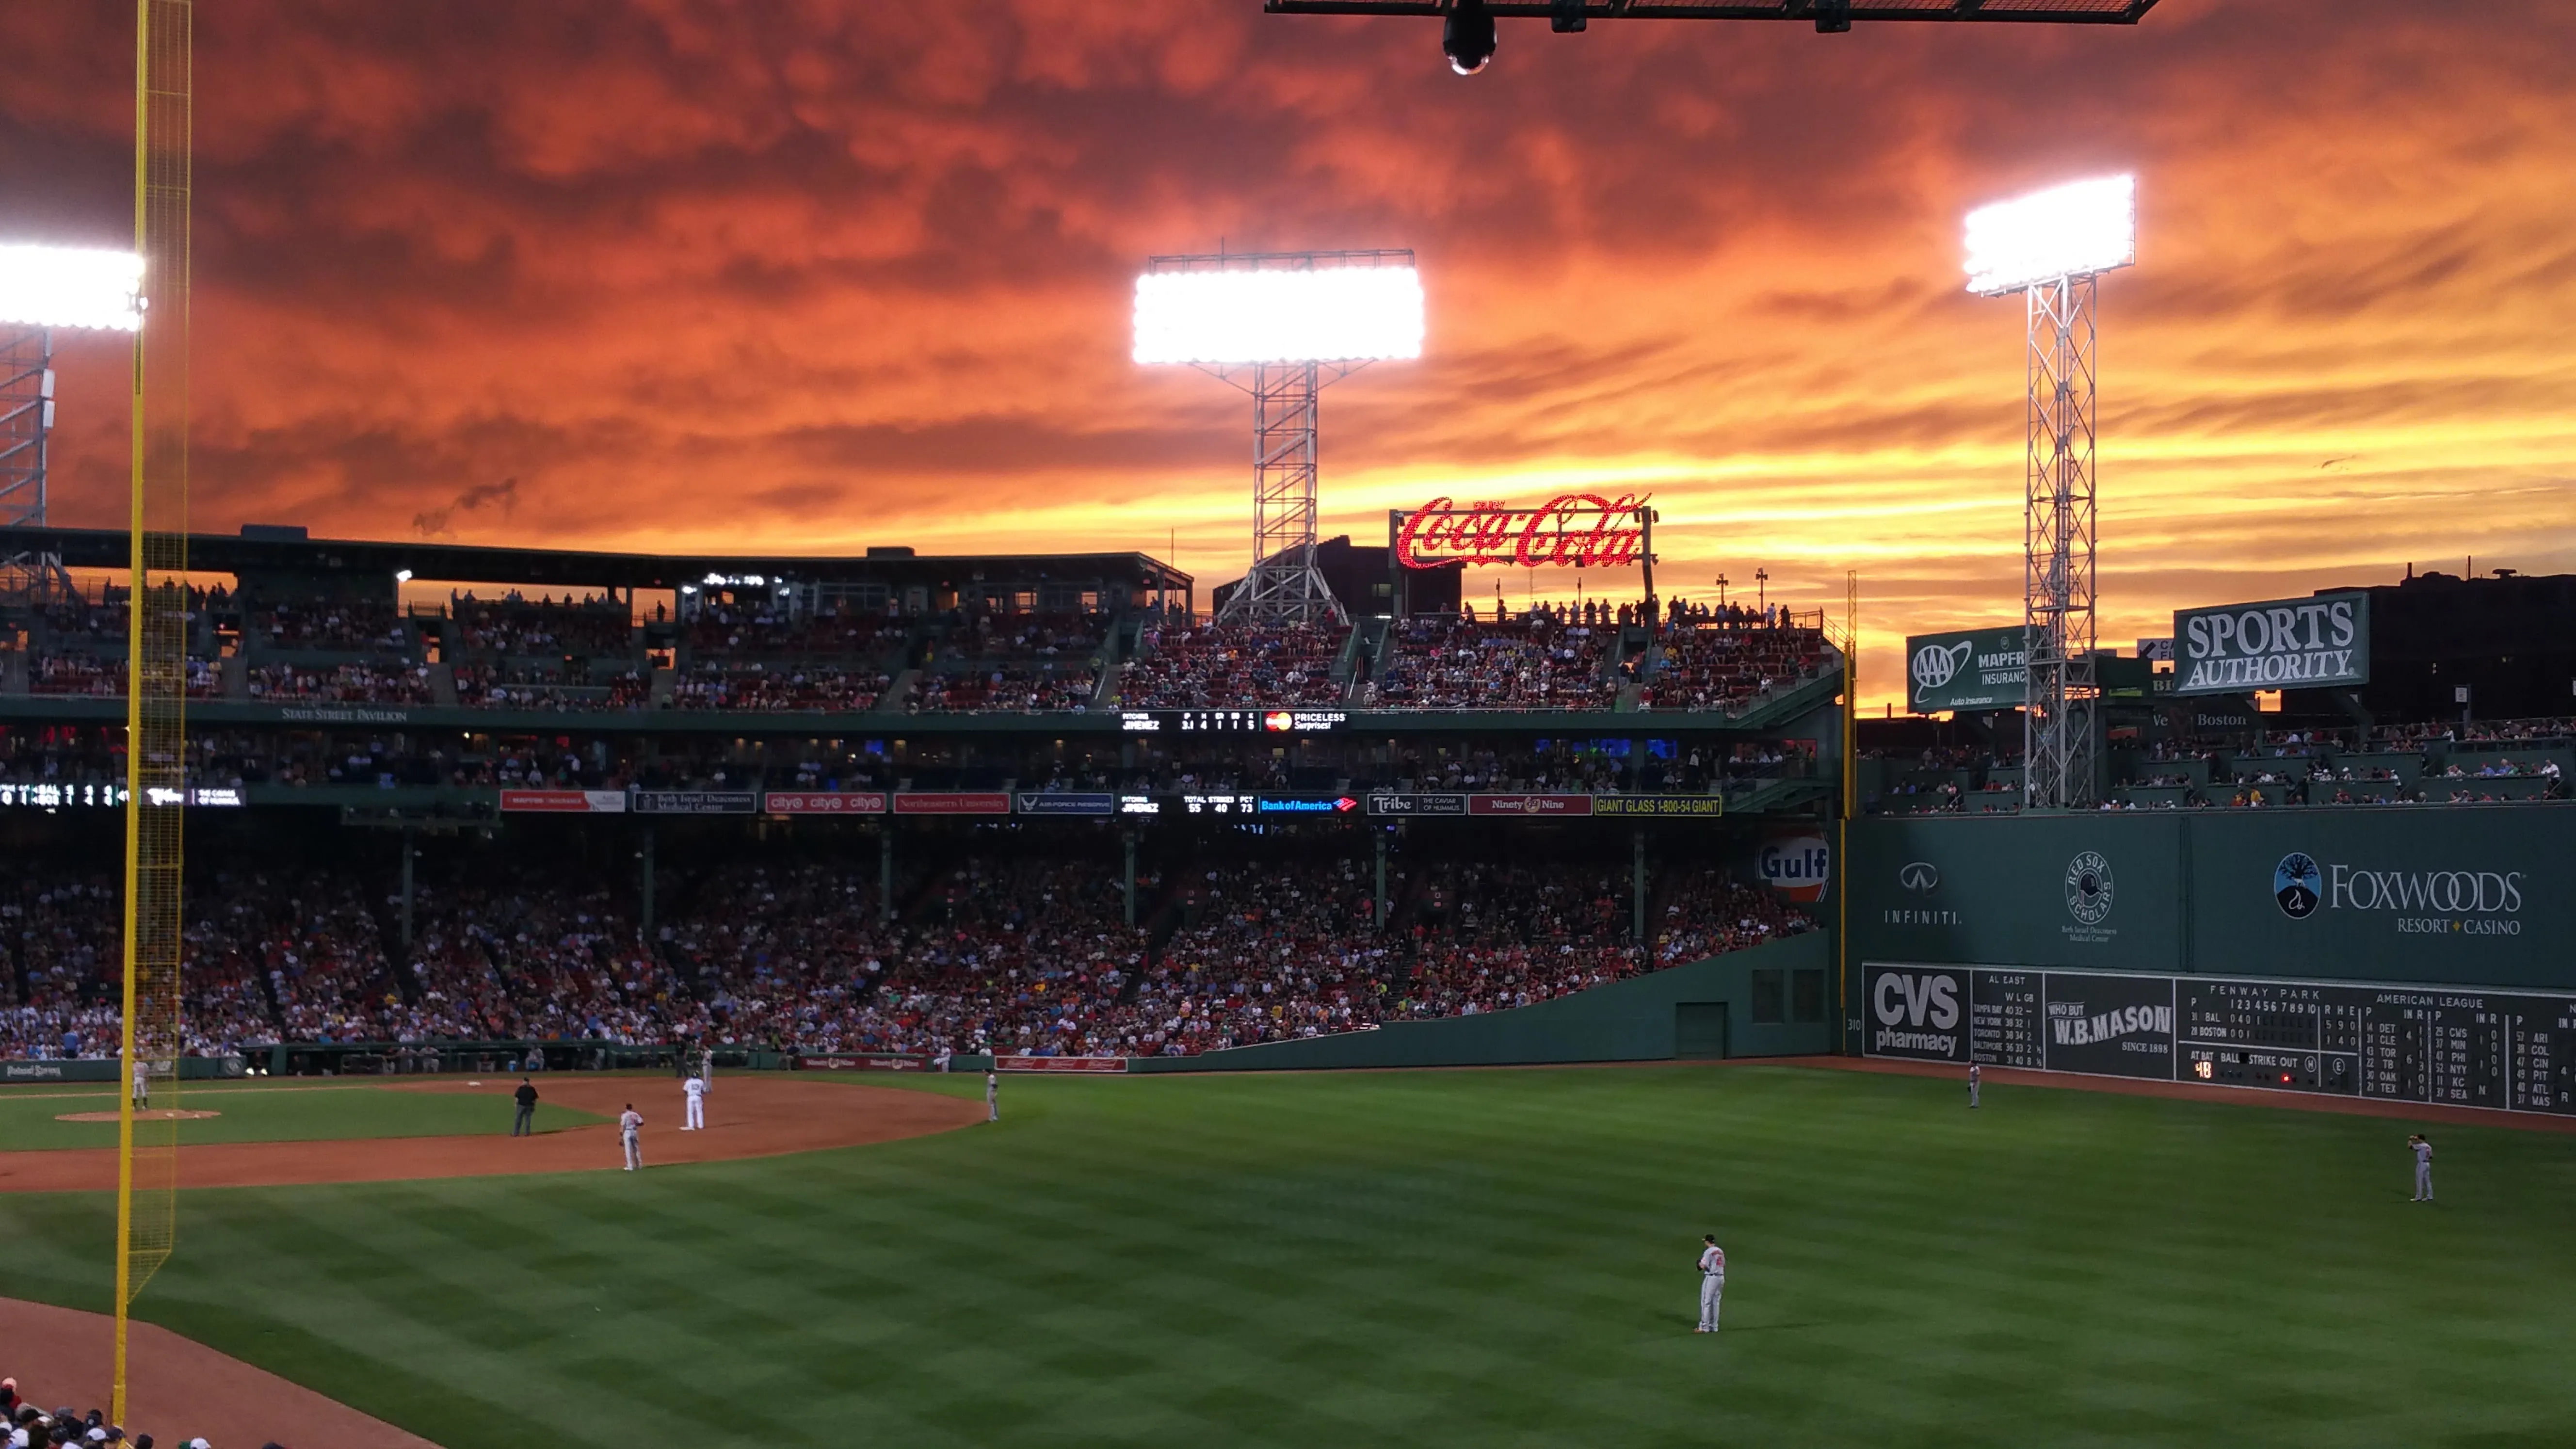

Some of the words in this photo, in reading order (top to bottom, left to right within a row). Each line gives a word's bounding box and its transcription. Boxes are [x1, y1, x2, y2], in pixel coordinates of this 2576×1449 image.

[1396, 492, 1651, 569] Coca-Cola
[2187, 601, 2354, 659] SPORTS
[1978, 651, 2025, 668] MAPFR
[1918, 646, 1950, 687] AAA
[1982, 671, 2025, 686] INSURANC
[1950, 697, 1964, 707] Auto
[1965, 696, 1993, 705] Insurance
[1294, 713, 1344, 722] PRICELESS
[2198, 713, 2247, 725] Boston
[1122, 721, 1159, 730] JIMENEZ
[1182, 721, 1194, 729] 3.1
[1200, 721, 1207, 729] 4
[1248, 721, 1255, 729] 5
[1294, 721, 1331, 731] Surprises!
[1122, 803, 1159, 812] JIMENEZ
[1189, 804, 1201, 812] 55
[1215, 804, 1227, 812] 40
[1241, 804, 1253, 812] 73
[1262, 801, 1284, 810] Bank
[1285, 801, 1294, 810] of
[1295, 801, 1332, 810] America
[1373, 796, 1412, 813] Tribe
[1492, 800, 1523, 810] Ninety
[1542, 800, 1564, 809] Nine
[1597, 799, 1624, 812] GIANT
[1626, 799, 1655, 812] GLASS
[1657, 799, 1690, 813] 1-800-54
[1692, 800, 1718, 813] GIANT
[1761, 846, 1826, 878] Gulf
[2068, 858, 2084, 886] RED
[2086, 854, 2105, 873] SOX
[2330, 864, 2521, 912] FOXWOODS
[2070, 882, 2111, 921] SCHOLARS
[1884, 910, 1956, 925] INFINITI
[2398, 918, 2449, 934] RESORT
[2463, 919, 2521, 935] CASINO
[1989, 975, 1999, 983] AL
[2003, 976, 2026, 985] EAST
[2005, 992, 2013, 1002] W
[2016, 993, 2021, 1002] L
[2210, 985, 2269, 997] FENWAY
[2280, 988, 2320, 1000] PARK
[1874, 972, 1959, 1030] CVS
[2376, 995, 2433, 1005] AMERICAN
[2439, 997, 2483, 1009] LEAGUE
[2005, 1005, 2013, 1015] 40
[2015, 1006, 2023, 1015] 32
[2047, 1004, 2067, 1016] WHO
[2068, 1004, 2084, 1016] BUT
[2237, 999, 2243, 1010] 2
[2245, 1000, 2251, 1011] 3
[2254, 1000, 2261, 1011] 4
[2263, 1000, 2269, 1012] 5
[2270, 1001, 2277, 1012] 6
[2281, 1001, 2287, 1012] 7
[2289, 1002, 2296, 1013] 8
[2297, 1003, 2304, 1014] 9
[2307, 1004, 2316, 1014] 10
[2324, 1004, 2331, 1014] R
[2337, 1005, 2343, 1015] H
[2349, 1006, 2355, 1016] E
[1848, 1019, 1861, 1031] 310
[2015, 1018, 2023, 1028] 32
[2205, 1012, 2221, 1023] BAL
[2230, 1014, 2236, 1023] 0
[2238, 1014, 2243, 1024] 4
[2245, 1014, 2251, 1025] 0
[2326, 1019, 2332, 1029] 5
[2337, 1020, 2344, 1030] 9
[2350, 1021, 2356, 1030] 0
[2379, 1023, 2396, 1033] DET
[2449, 1028, 2467, 1038] CWS
[2015, 1030, 2023, 1040] 34
[2199, 1027, 2227, 1037] BOSTON
[2338, 1035, 2344, 1045] 4
[2380, 1035, 2396, 1045] CLE
[2533, 1032, 2548, 1043] ARI
[1876, 1027, 1957, 1057] pharmacy
[2015, 1043, 2023, 1052] 33
[2451, 1040, 2466, 1050] MIN
[2122, 1042, 2147, 1052] SINCE
[2149, 1044, 2168, 1054] 1898
[2380, 1047, 2396, 1057] TOR
[2531, 1045, 2549, 1056] COL
[2015, 1056, 2023, 1065] 40
[2190, 1050, 2200, 1060] AT
[2201, 1052, 2213, 1061] BAT
[2221, 1053, 2240, 1063] BALL
[2248, 1054, 2276, 1066] STRIKE
[2280, 1057, 2298, 1068] OUT
[2451, 1052, 2466, 1063] PHI
[2383, 1059, 2394, 1069] TB
[2532, 1058, 2549, 1069] CIN
[2450, 1064, 2467, 1075] NYY
[2379, 1071, 2396, 1082] OAK
[2533, 1070, 2548, 1081] PIT
[2452, 1077, 2465, 1087] KC
[2380, 1083, 2396, 1094] TEX
[2532, 1083, 2549, 1095] ATL
[2450, 1089, 2467, 1100] SEA
[2531, 1096, 2550, 1107] WAS
